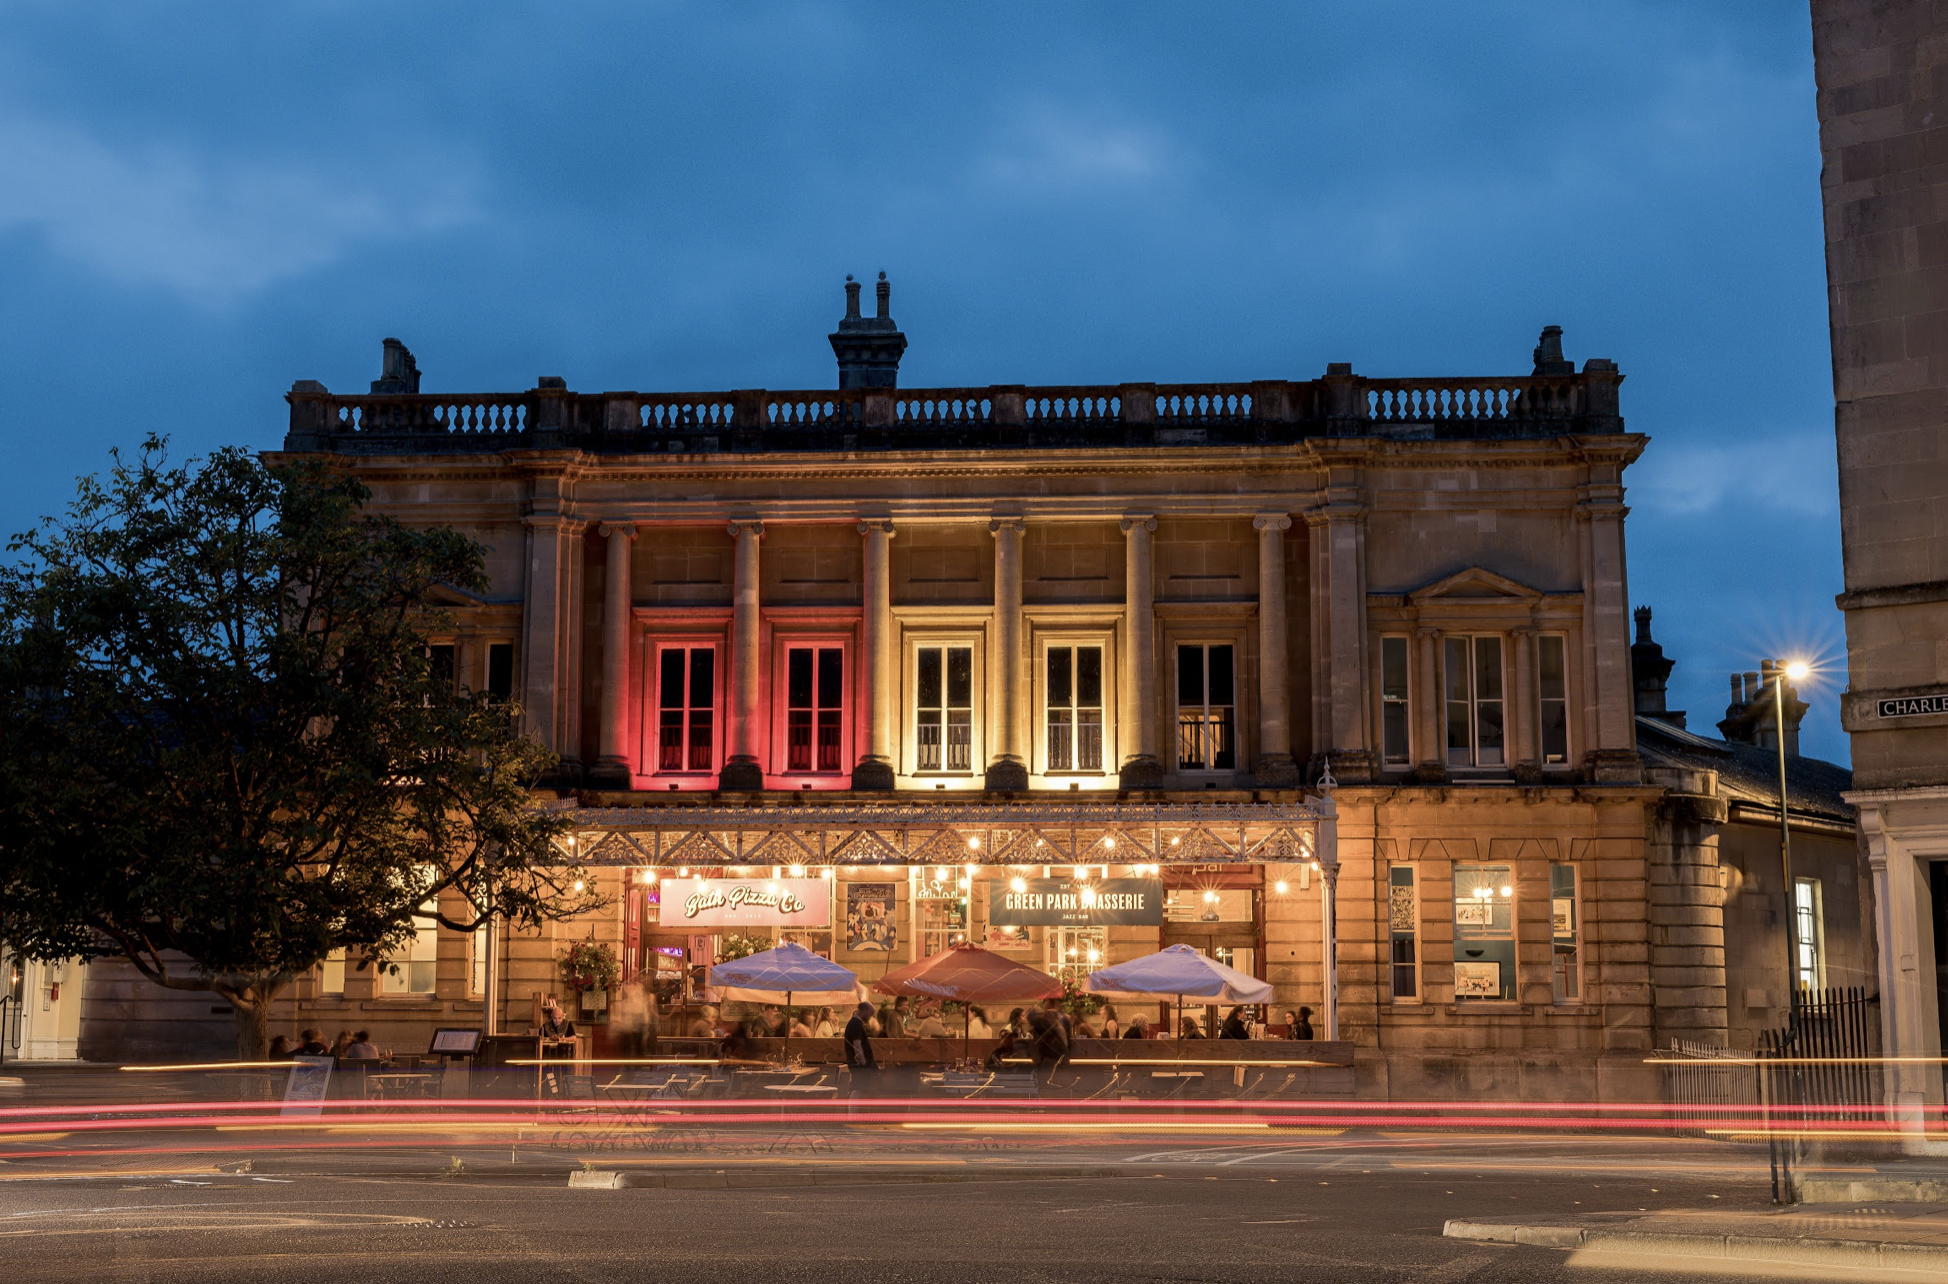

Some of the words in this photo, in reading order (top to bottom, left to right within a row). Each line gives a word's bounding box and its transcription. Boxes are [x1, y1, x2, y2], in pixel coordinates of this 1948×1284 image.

[685, 890, 726, 918] Bath
[728, 886, 779, 910] Pizza
[779, 892, 805, 914] Co
[1006, 893, 1043, 910] GREEN
[1047, 893, 1077, 910] PARK
